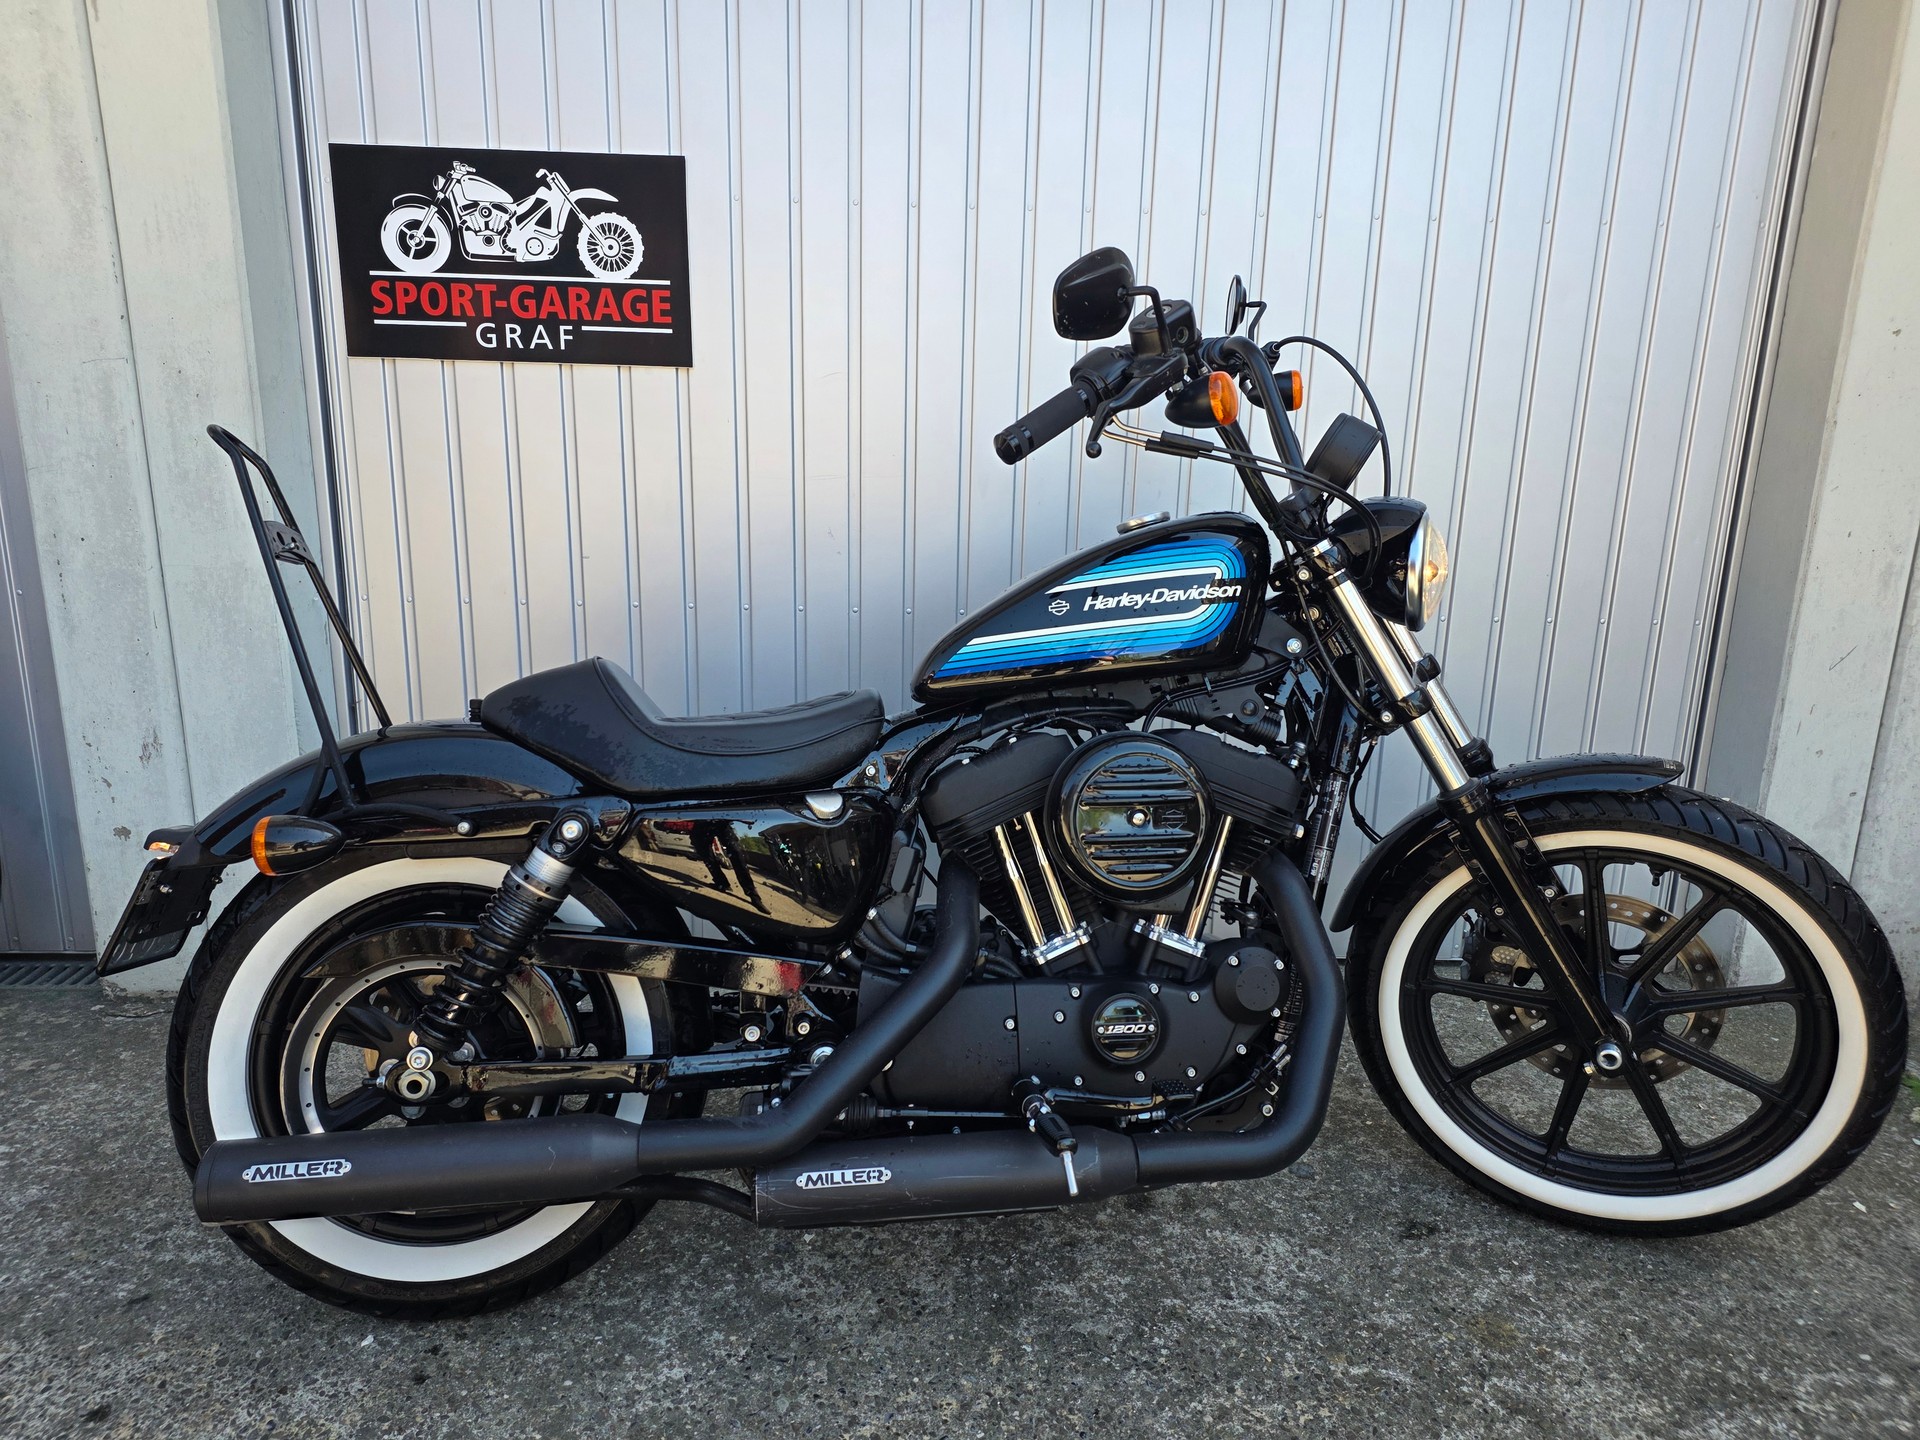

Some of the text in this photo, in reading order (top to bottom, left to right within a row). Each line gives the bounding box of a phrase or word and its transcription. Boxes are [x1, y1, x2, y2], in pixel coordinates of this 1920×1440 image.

[370, 281, 672, 323] SPORT-GARAGE
[475, 323, 573, 350] GRAF
[1083, 584, 1241, 611] Harley-Davidson
[1106, 1024, 1146, 1034] 1200
[250, 1160, 344, 1181] MILLER
[804, 1168, 885, 1188] MILLER
